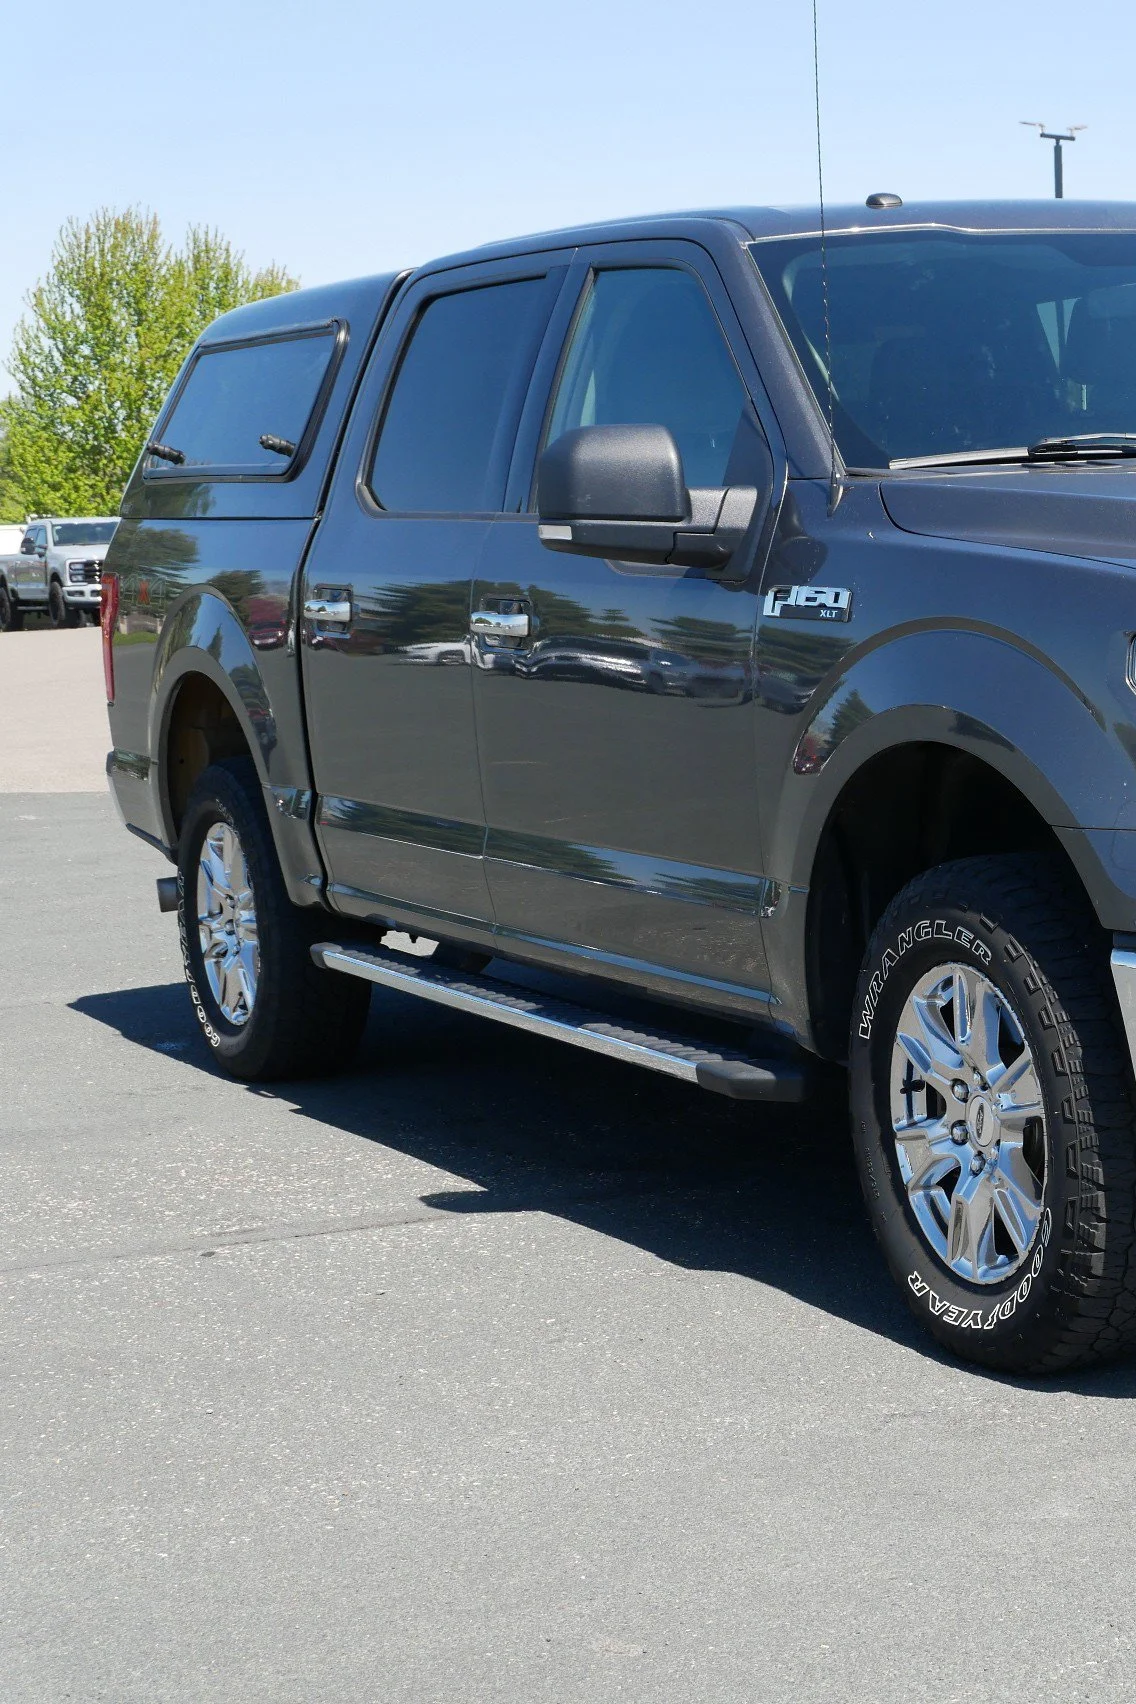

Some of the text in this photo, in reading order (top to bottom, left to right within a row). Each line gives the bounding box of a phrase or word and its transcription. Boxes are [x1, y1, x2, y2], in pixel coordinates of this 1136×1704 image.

[820, 609, 838, 618] XLT
[858, 919, 993, 1039] WRANGLER
[907, 1206, 1053, 1330] GOODYEAR
